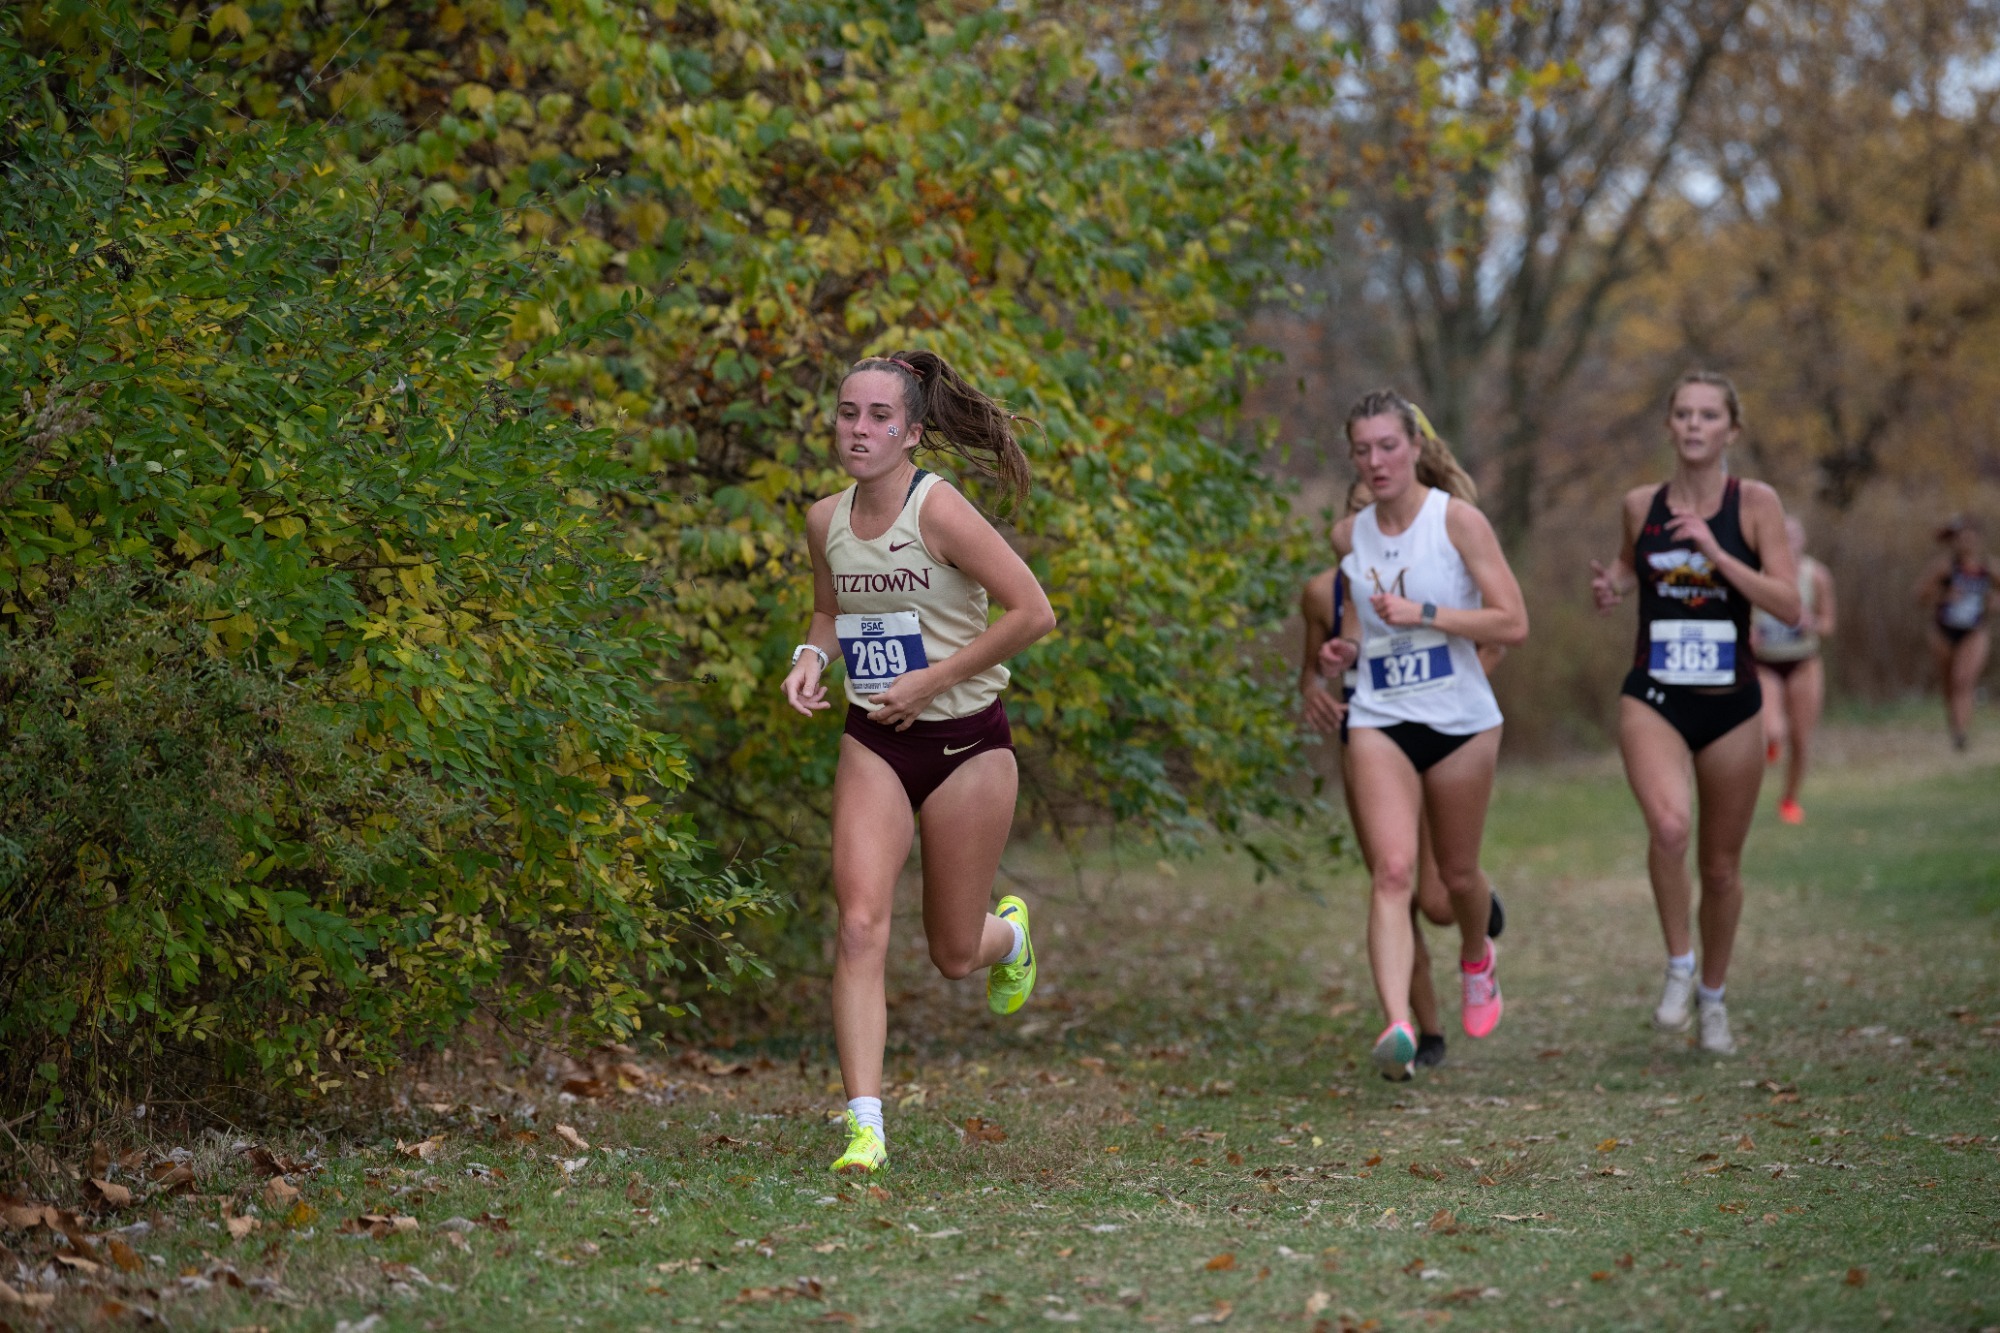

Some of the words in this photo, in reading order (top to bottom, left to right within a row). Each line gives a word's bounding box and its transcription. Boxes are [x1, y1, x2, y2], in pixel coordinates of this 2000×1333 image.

[832, 568, 930, 596] UTZTOWN
[861, 621, 884, 631] PSAC
[852, 639, 907, 676] 269
[1384, 650, 1430, 686] 327
[1665, 641, 1719, 671] 363
